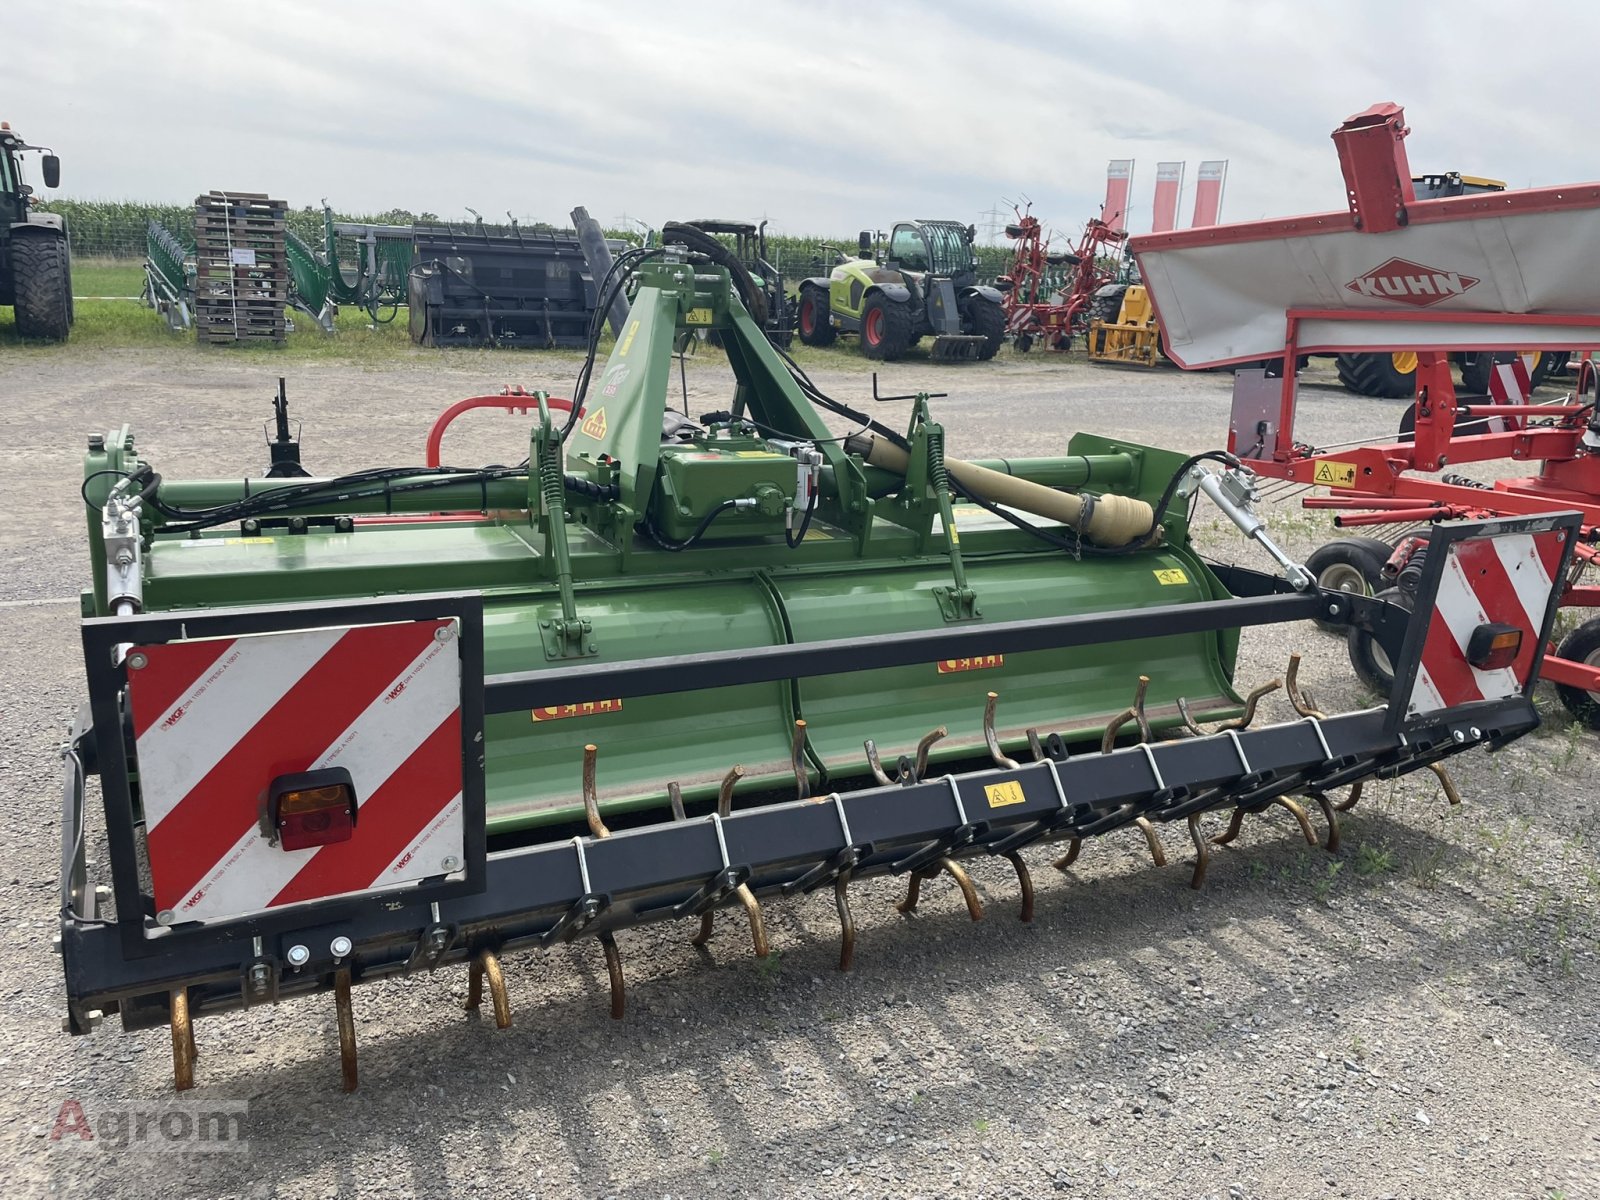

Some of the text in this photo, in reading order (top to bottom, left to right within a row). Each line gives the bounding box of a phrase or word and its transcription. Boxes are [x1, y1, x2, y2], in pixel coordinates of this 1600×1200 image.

[1354, 271, 1465, 297] KUHN
[388, 681, 405, 699] WGF
[165, 706, 184, 726] WGF
[396, 852, 412, 868] WGF
[186, 890, 204, 907] WGF
